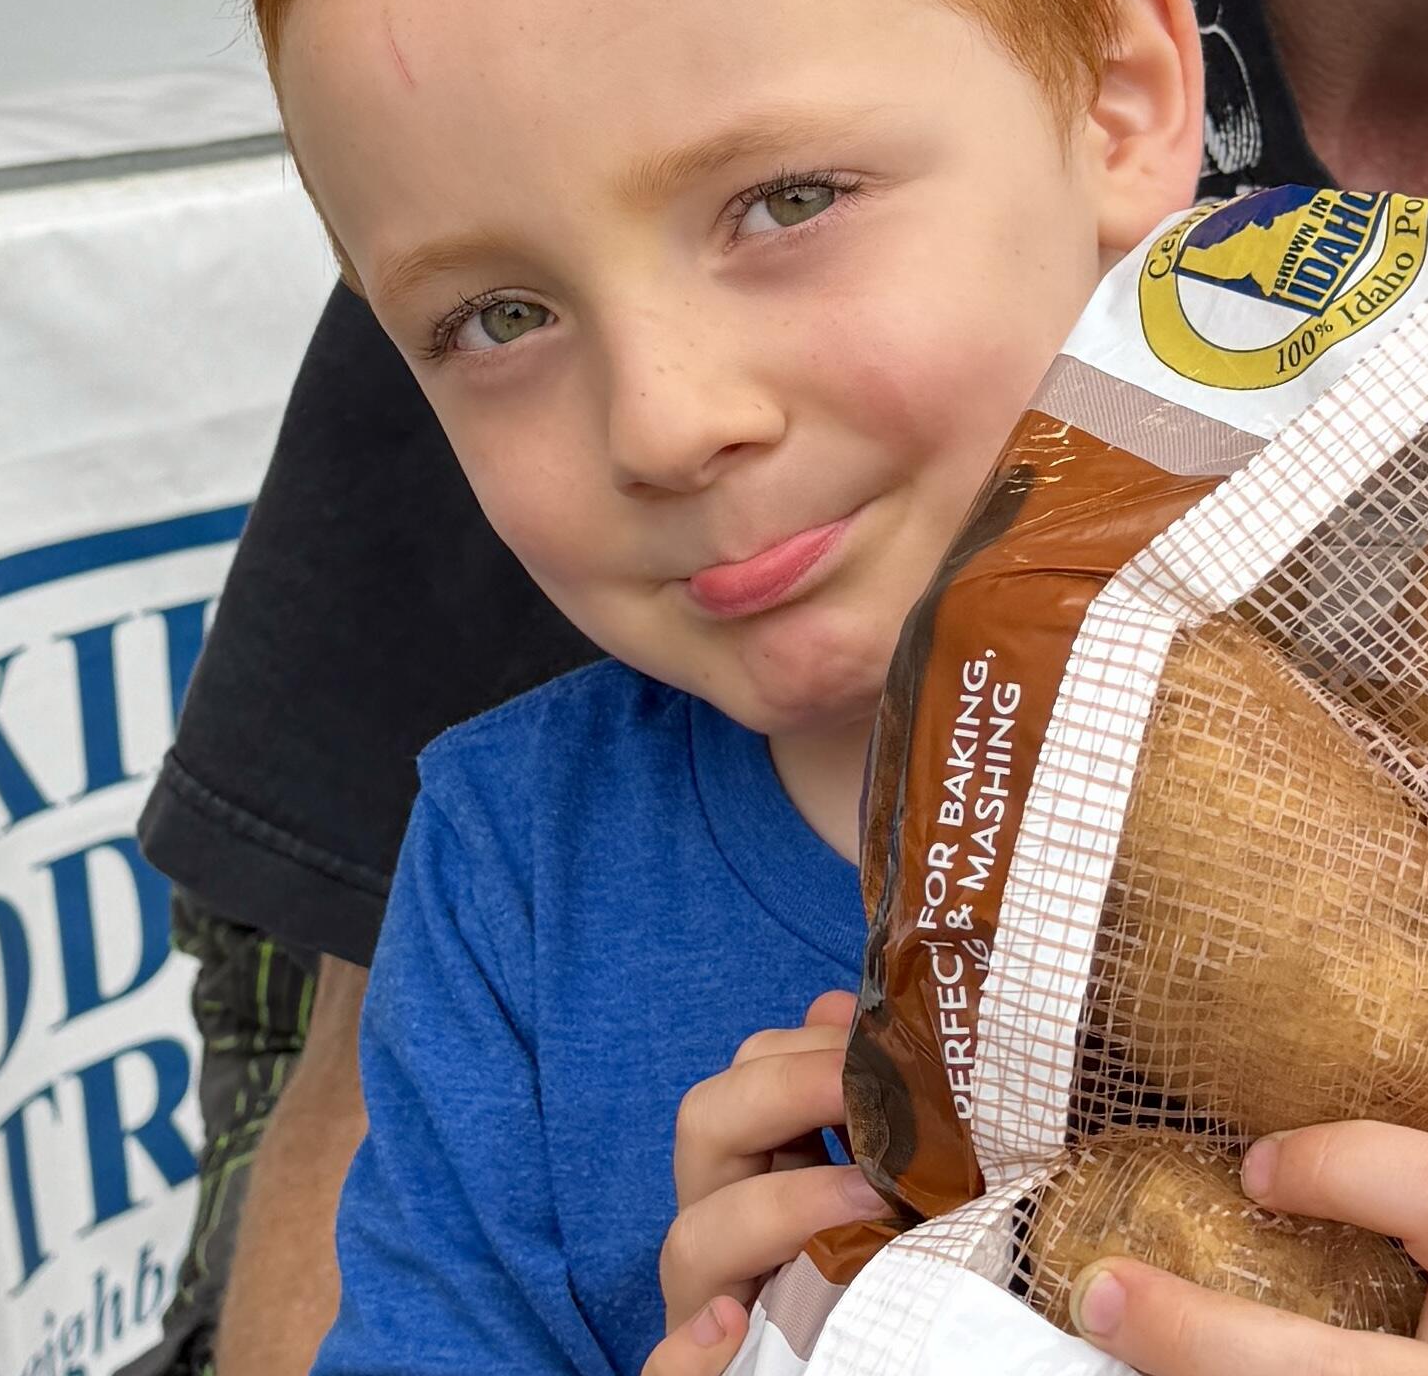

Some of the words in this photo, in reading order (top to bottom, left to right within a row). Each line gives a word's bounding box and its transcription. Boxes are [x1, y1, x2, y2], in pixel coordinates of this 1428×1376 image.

[1274, 222, 1319, 292] GROWN
[1308, 196, 1332, 221] IN
[1275, 319, 1334, 374] 100%
[1336, 252, 1414, 326] Idaho
[937, 648, 997, 827] BAKING,
[956, 682, 1021, 891] MASHING
[916, 842, 959, 929] FOR
[945, 903, 974, 931] &
